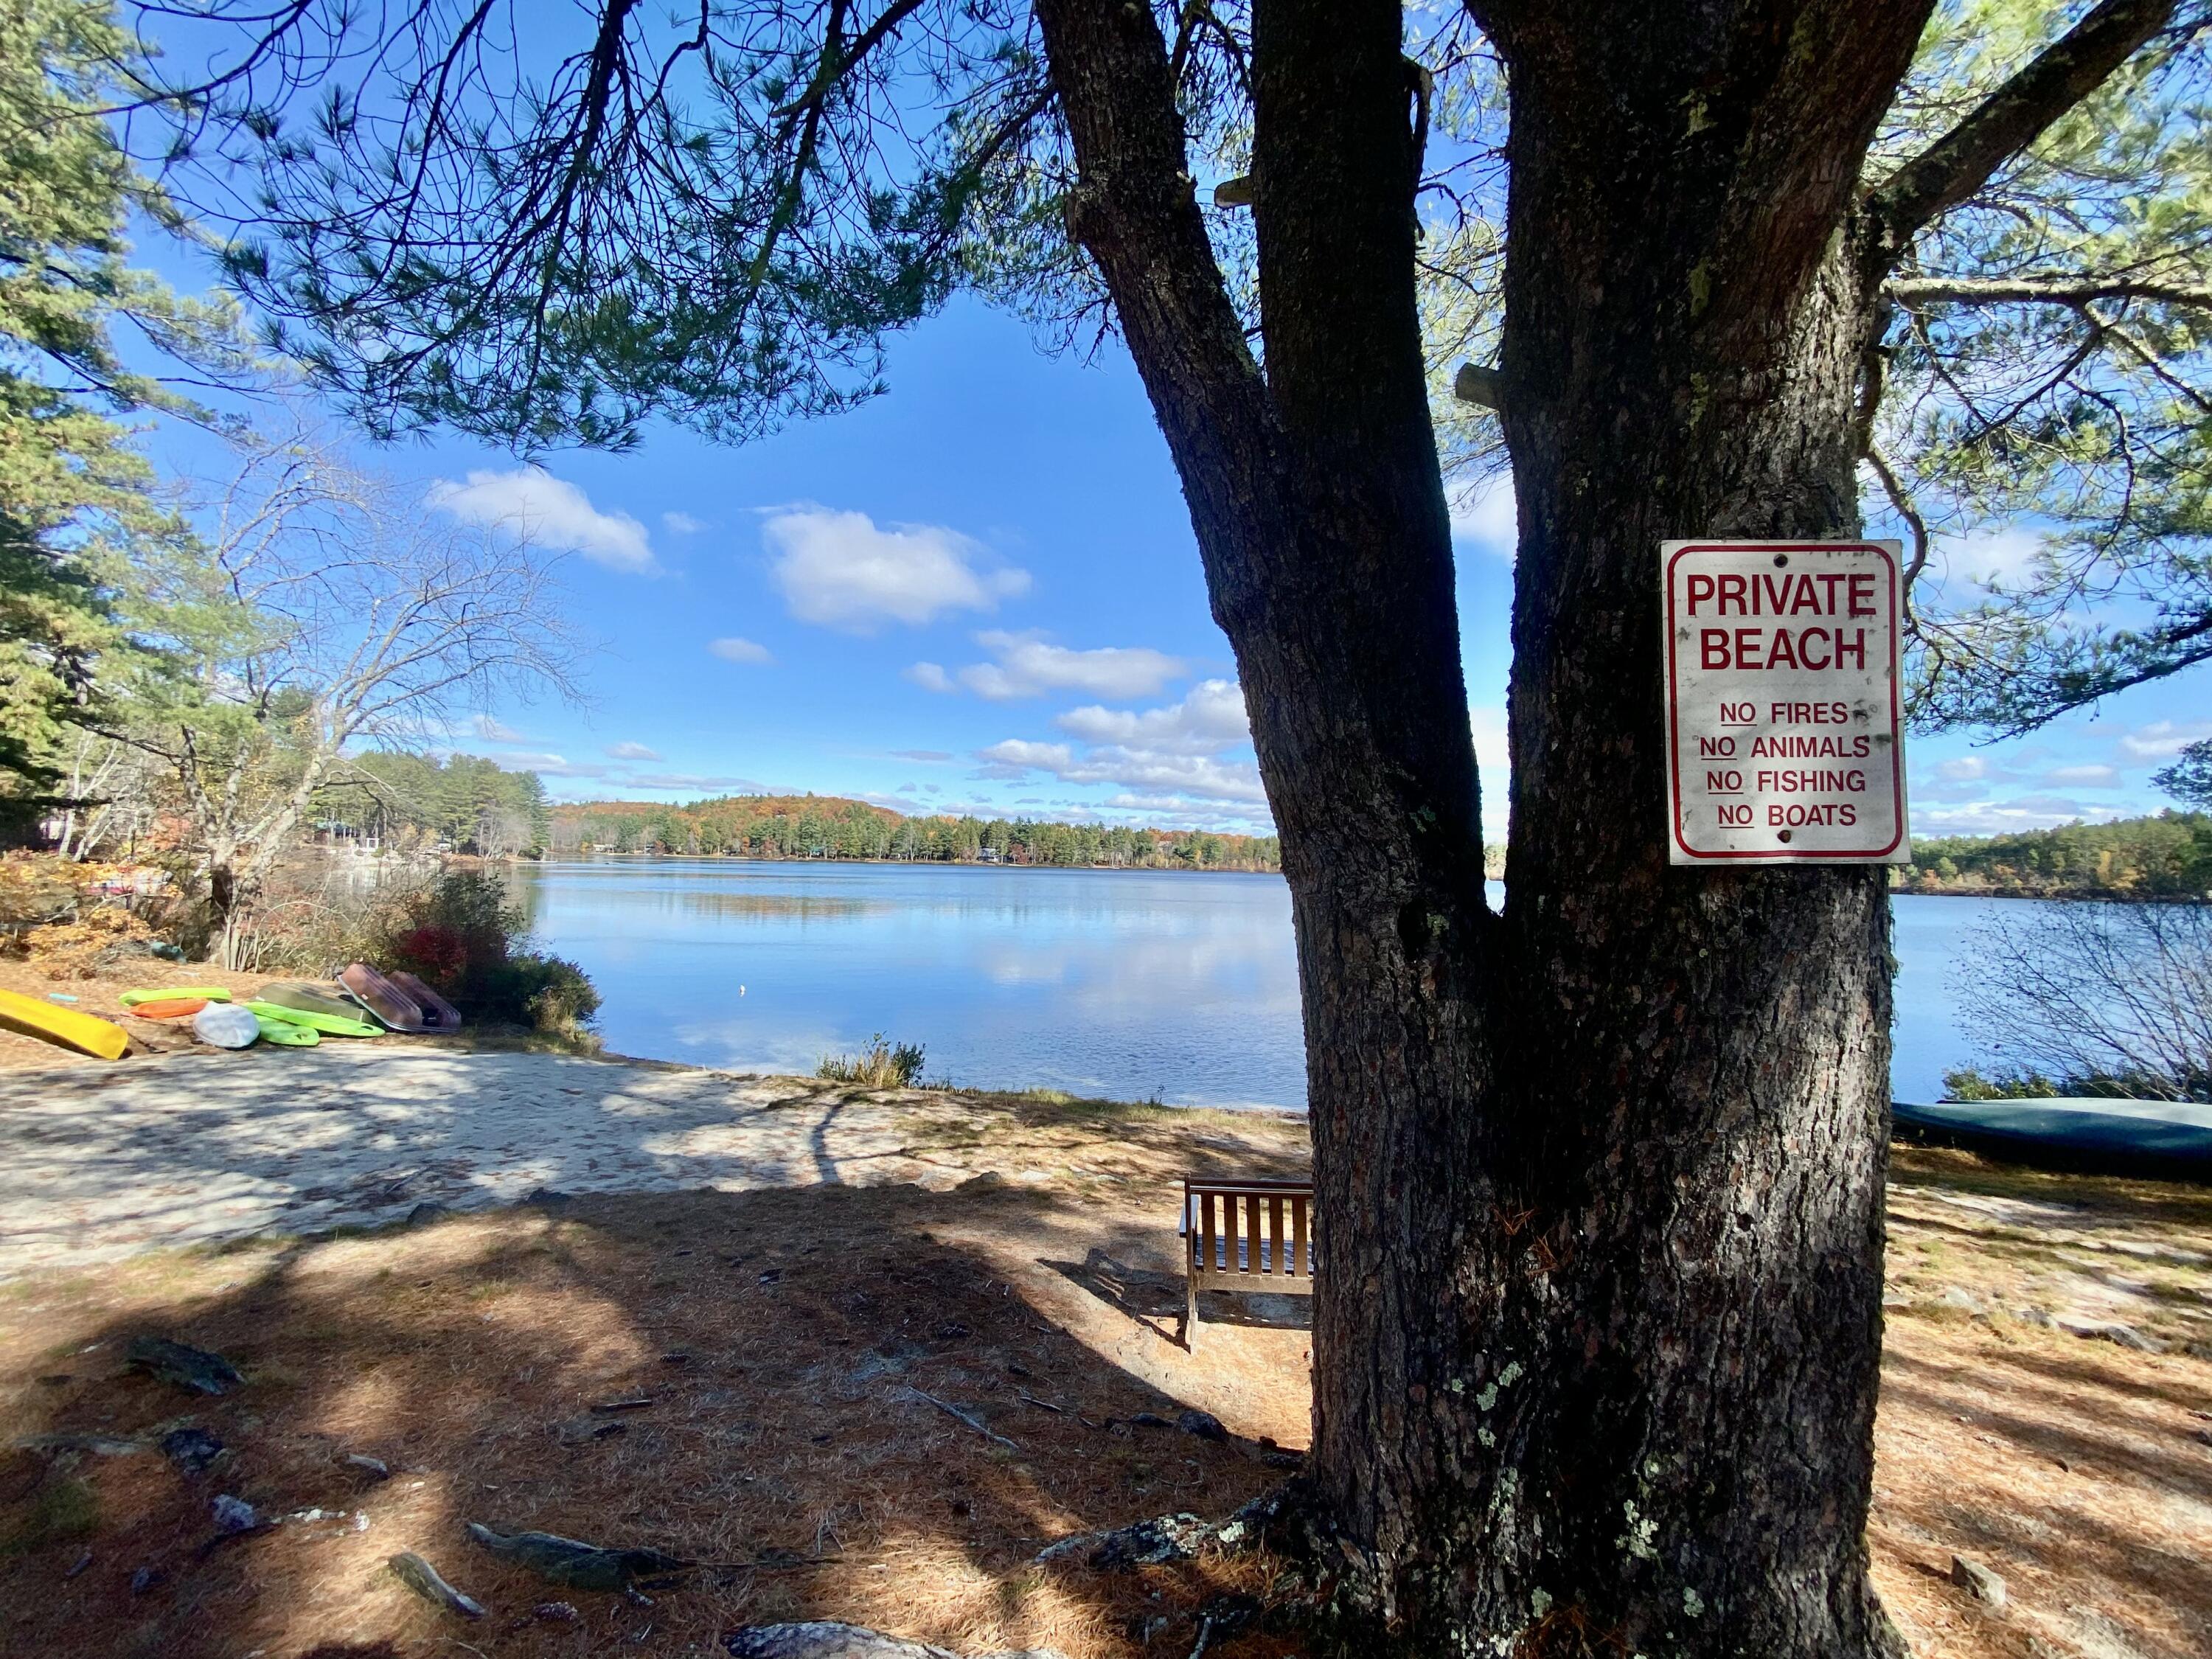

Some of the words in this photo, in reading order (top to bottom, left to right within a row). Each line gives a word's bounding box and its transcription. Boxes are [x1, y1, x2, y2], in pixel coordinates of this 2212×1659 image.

[1687, 574, 1877, 616] PRIVATE
[1700, 627, 1865, 670] BEACH
[1720, 703, 1756, 723] NO
[1771, 702, 1848, 724] FIRES
[1700, 737, 1736, 757] NO
[1751, 736, 1870, 758] ANIMALS
[1707, 771, 1743, 790] NO
[1758, 770, 1866, 792] FISHING
[1718, 804, 1753, 824] NO
[1767, 804, 1857, 827] BOATS
